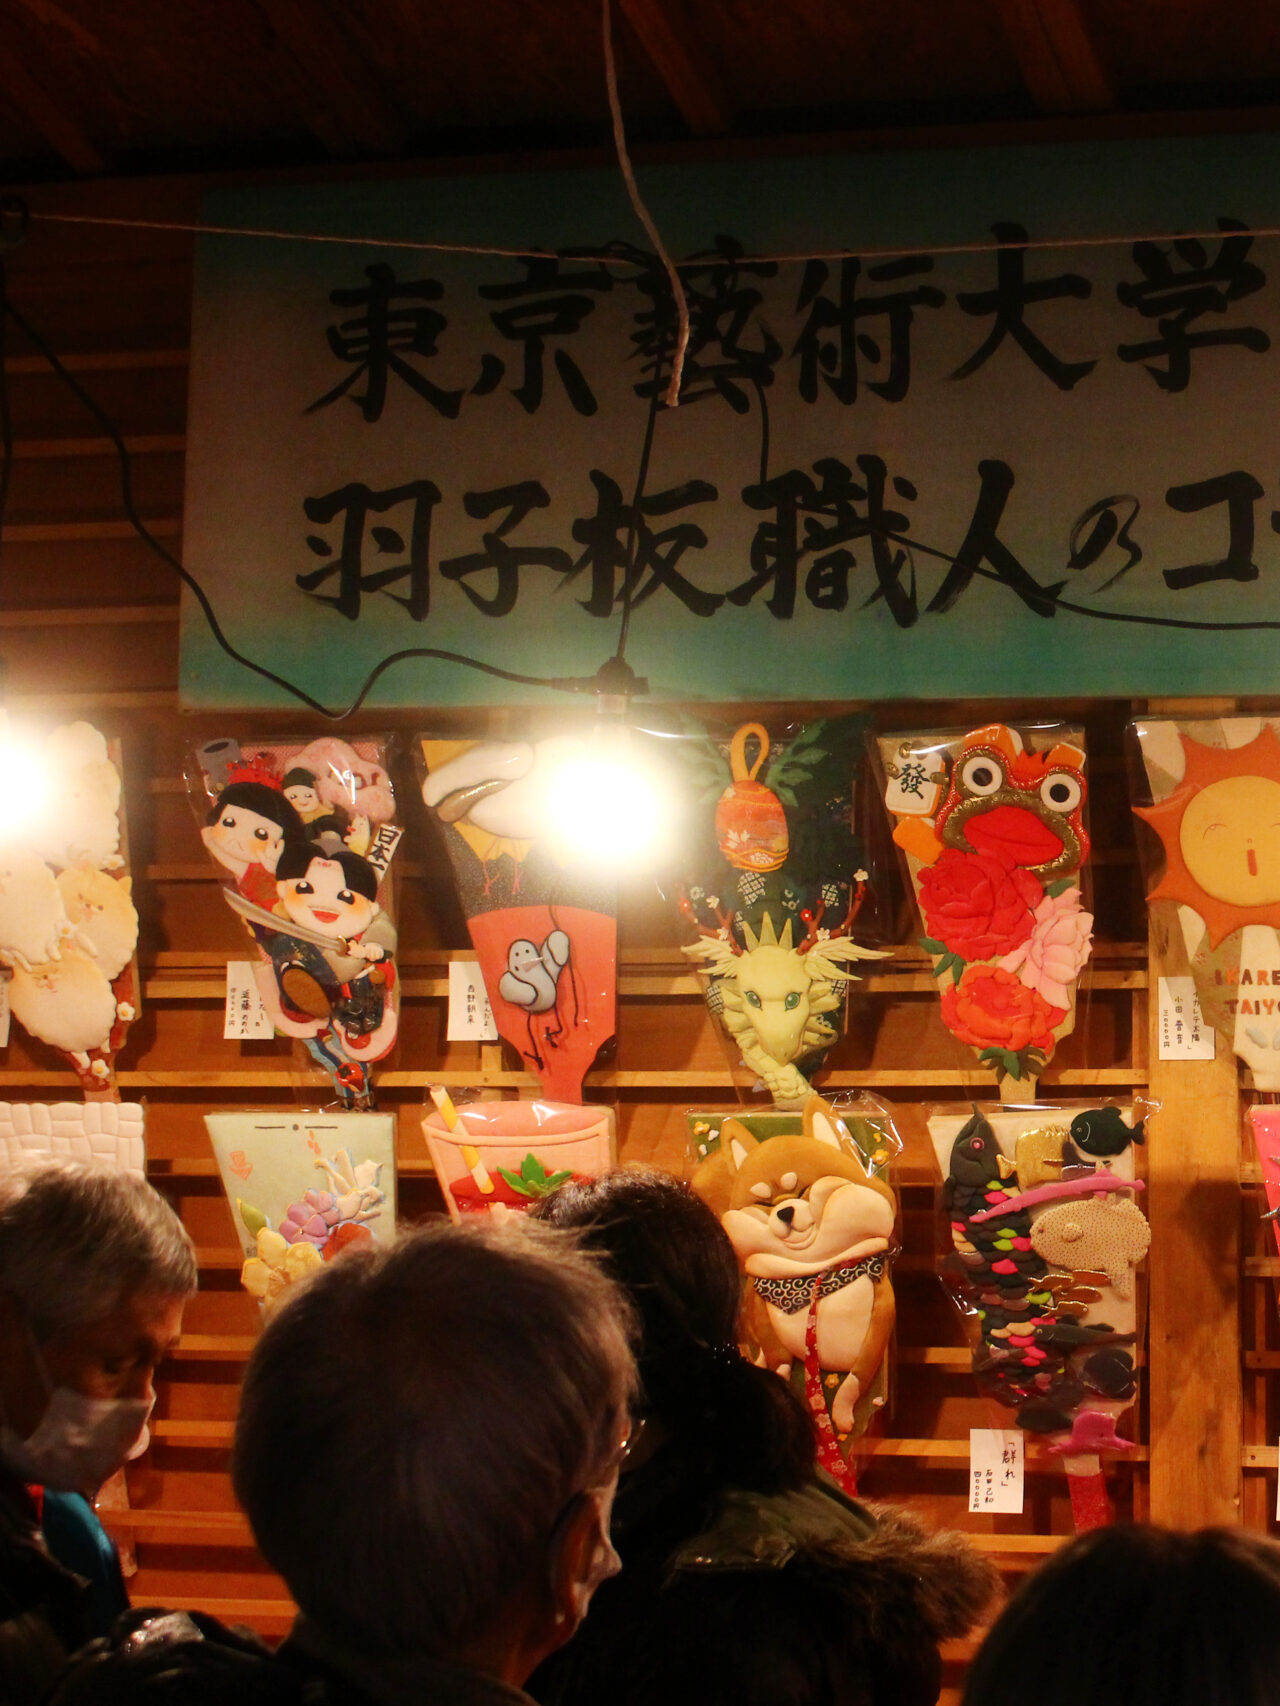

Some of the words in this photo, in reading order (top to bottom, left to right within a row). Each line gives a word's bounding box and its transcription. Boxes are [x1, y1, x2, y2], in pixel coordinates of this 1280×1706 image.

[895, 763, 930, 799] 發
[369, 827, 400, 871] 日本一
